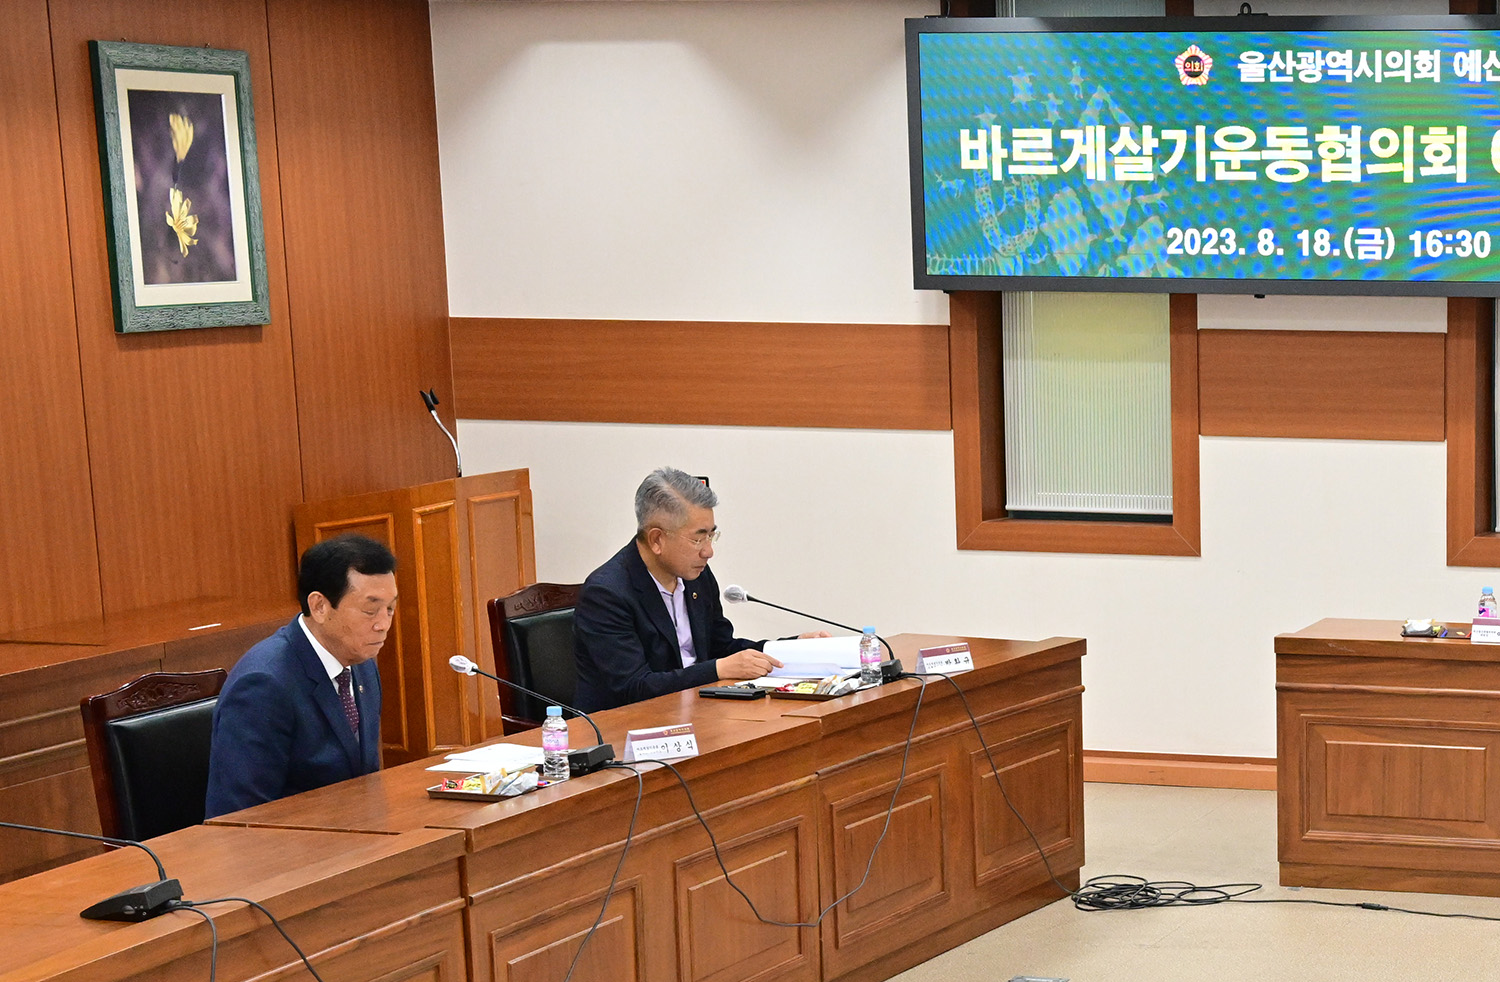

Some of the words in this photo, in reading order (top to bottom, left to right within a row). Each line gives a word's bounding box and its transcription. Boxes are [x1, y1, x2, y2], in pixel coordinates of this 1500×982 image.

[1184, 60, 1204, 73] 의회
[1238, 50, 1441, 83] 울산광역시의회
[960, 125, 1467, 183] 바르게살기운동협의회
[1167, 227, 1246, 256] 2023.
[1257, 228, 1284, 257] 8.
[1297, 226, 1396, 260] 18.(금)
[1409, 229, 1492, 258] 16:30
[660, 739, 694, 754] 이상식
